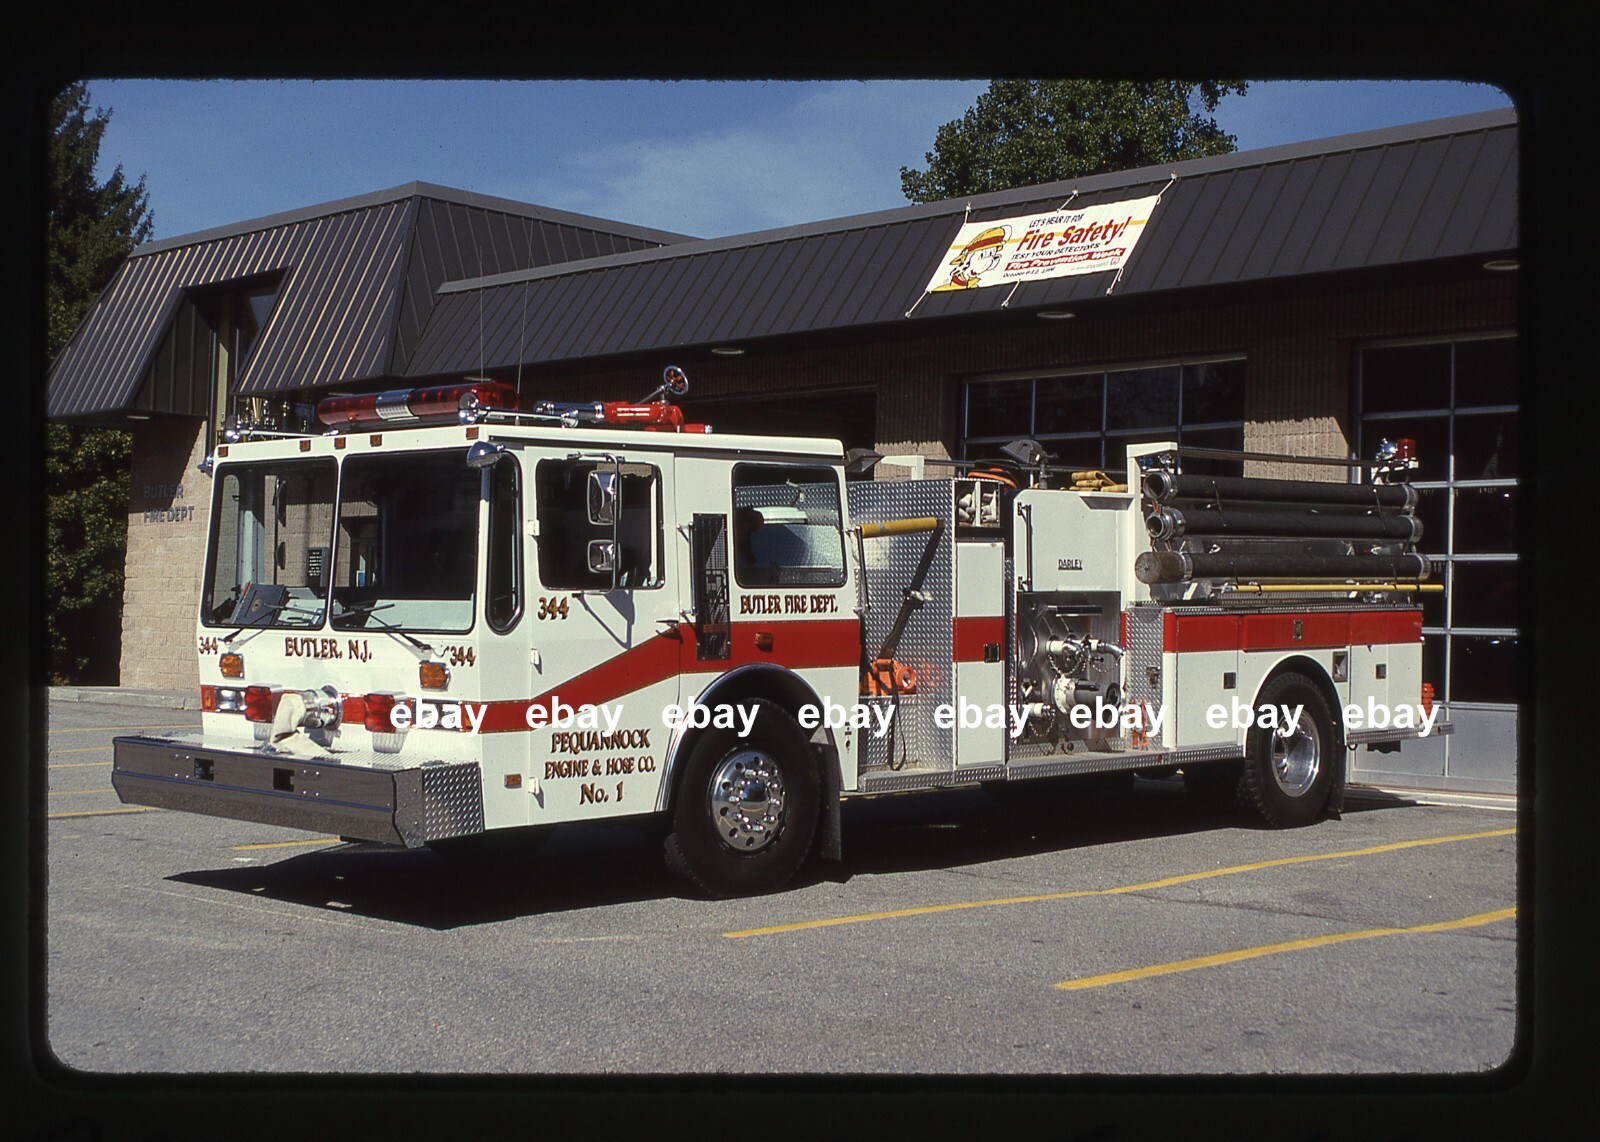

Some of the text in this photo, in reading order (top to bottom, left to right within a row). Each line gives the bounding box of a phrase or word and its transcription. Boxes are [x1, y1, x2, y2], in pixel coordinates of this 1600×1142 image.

[1029, 218, 1046, 228] LET'S
[1046, 215, 1064, 225] HEAR
[1016, 216, 1132, 251] Fire Safety!
[1008, 261, 1029, 270] Fire
[1031, 253, 1089, 267] Prevention
[1091, 248, 1123, 260] Week
[1011, 242, 1100, 261] TEST YOUR DETECTORS
[144, 483, 183, 499] BUTLER
[144, 506, 194, 523] FIRE DEPT
[1058, 558, 1083, 570] DARLEY
[537, 596, 570, 620] 344
[740, 594, 838, 615] BUTLER FIRE DEPT.
[199, 636, 219, 655] 344
[284, 636, 373, 663] BUTLER, N.J.
[449, 645, 476, 667] 344
[550, 728, 651, 754] PEQUANNOCK
[544, 755, 656, 780] ENGINE & HOSE CO.
[579, 781, 624, 805] No. 1
